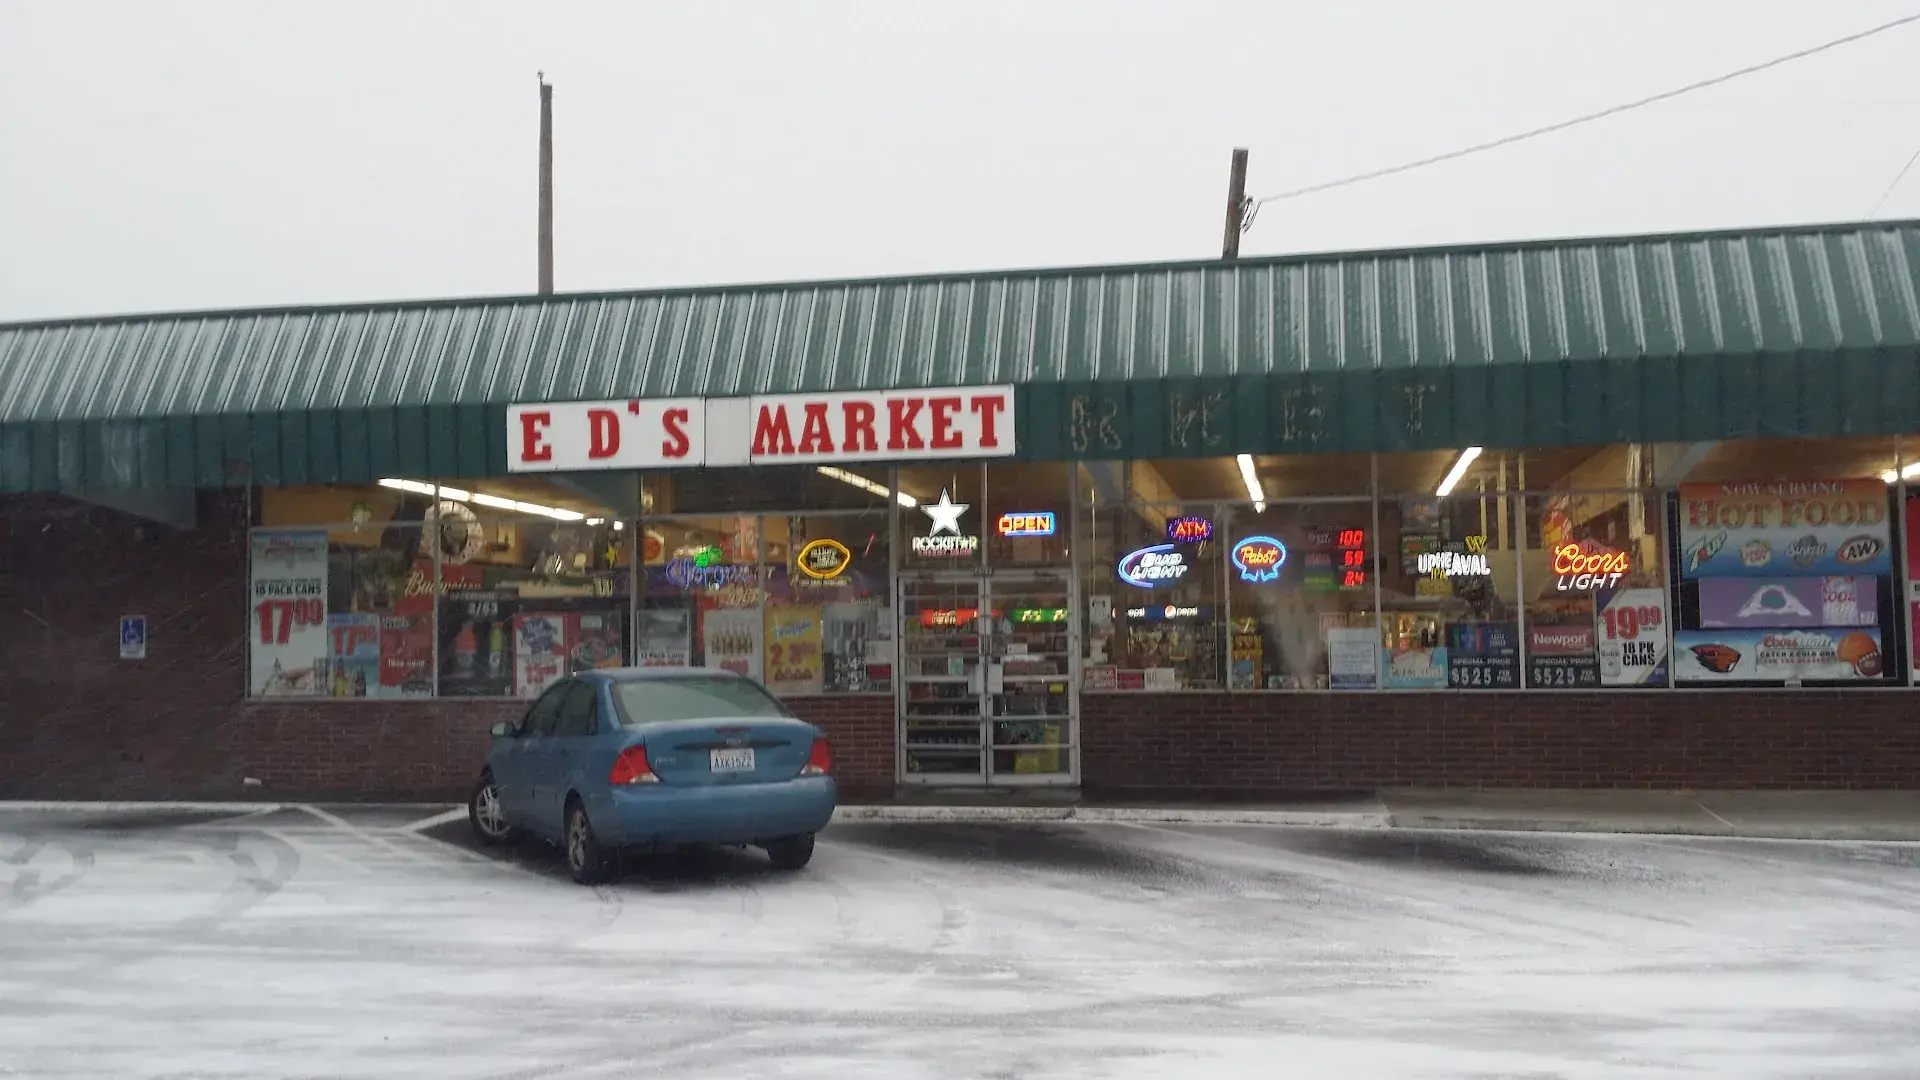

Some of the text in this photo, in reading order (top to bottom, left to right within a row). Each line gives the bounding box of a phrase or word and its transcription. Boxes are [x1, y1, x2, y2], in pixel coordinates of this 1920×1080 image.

[520, 395, 1005, 462] ED'S MARKET
[1722, 482, 1844, 496] NOW SERVING
[1687, 498, 1886, 529] HOT FOOD
[1000, 516, 1050, 532] OPEN
[1175, 522, 1208, 537] ATM
[911, 536, 979, 551] ROCKSTAR
[1140, 552, 1183, 567] BUD
[1240, 546, 1278, 565] Pabst
[1554, 543, 1628, 574] Coors
[1417, 551, 1491, 576] UPHEAVAL
[1130, 565, 1188, 580] LIGHT
[295, 582, 322, 595] CANS
[1557, 572, 1622, 591] LIGHT
[1176, 607, 1198, 617] pepsi
[1534, 633, 1587, 646] Newport
[1622, 642, 1655, 654] 18 PK
[1623, 653, 1656, 666] CANS
